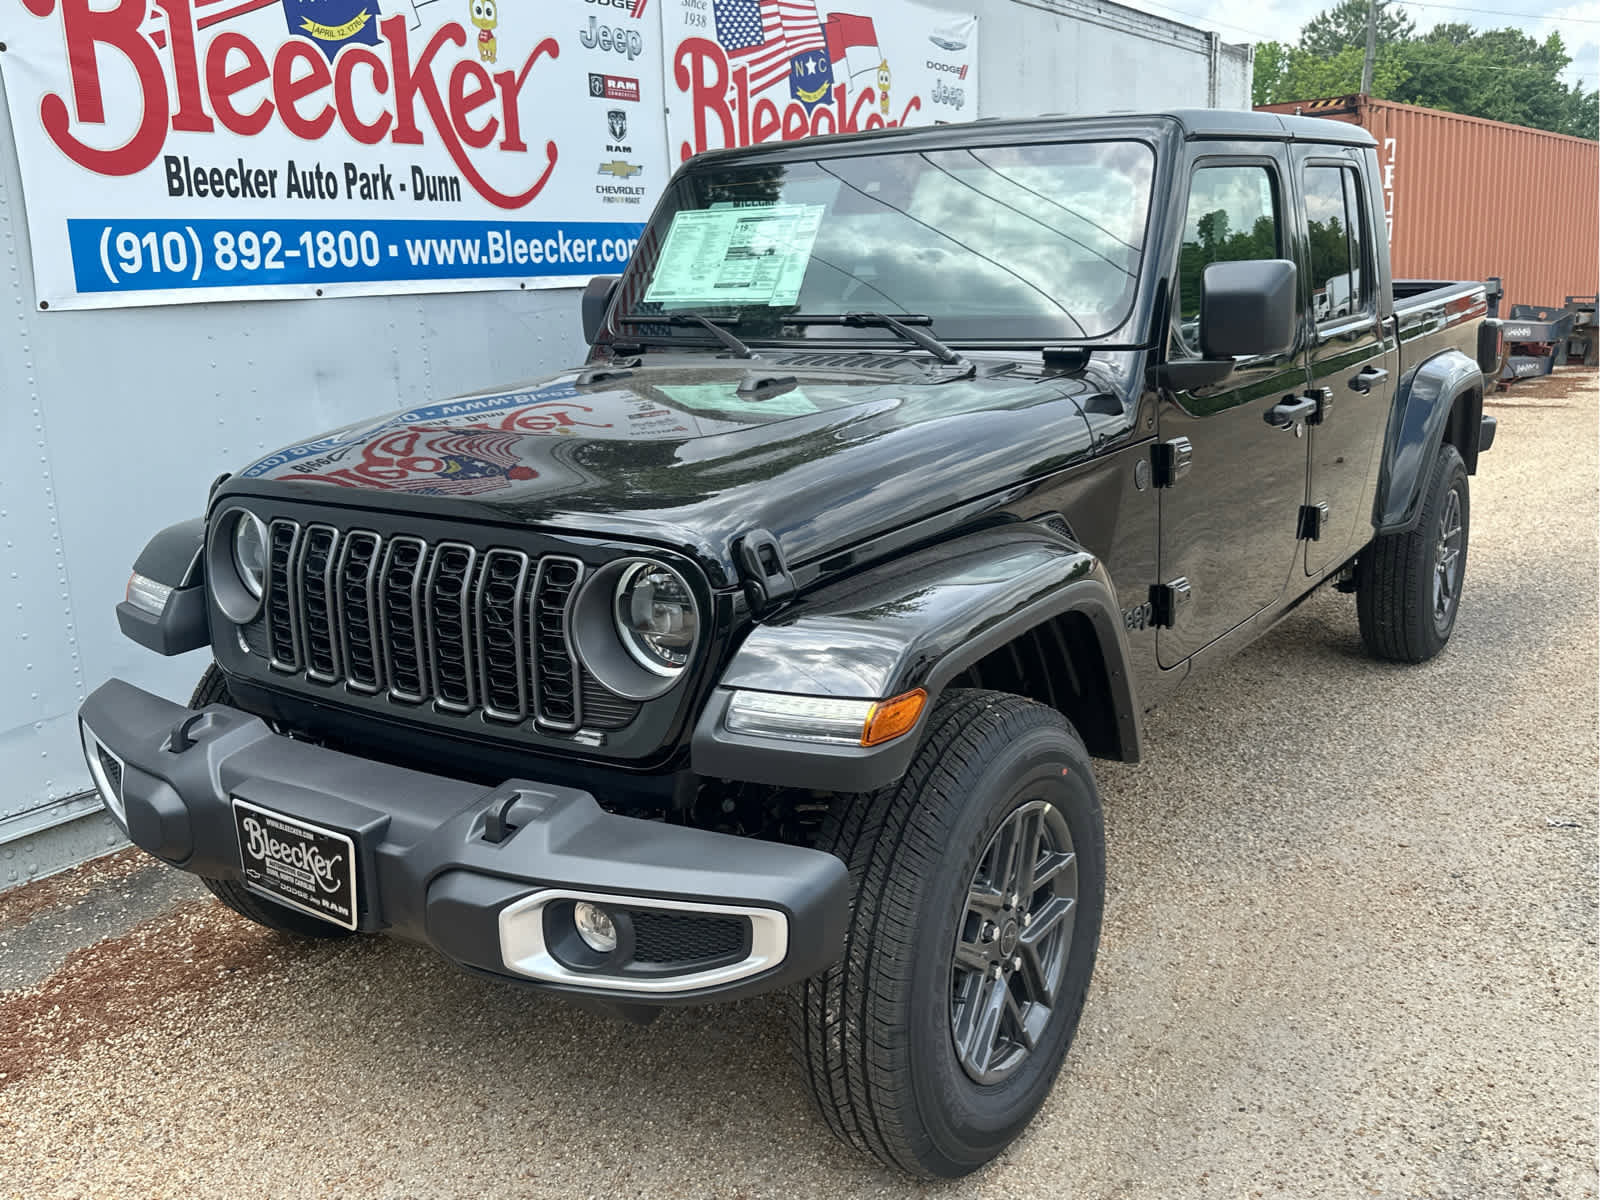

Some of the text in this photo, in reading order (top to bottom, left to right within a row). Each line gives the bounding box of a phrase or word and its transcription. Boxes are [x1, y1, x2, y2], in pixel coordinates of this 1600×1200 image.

[684, 12, 707, 28] 1938
[580, 16, 642, 61] Jeep
[795, 57, 827, 77] N C
[926, 61, 962, 75] DODGE
[607, 80, 637, 91] RAM
[932, 79, 964, 111] Jeep
[28, 0, 560, 210] Bleecker
[606, 145, 632, 153] RAM
[164, 155, 462, 202] Bleecker Auto Park Dunn
[596, 185, 645, 196] CHEVROLET
[99, 226, 203, 284] (910)
[213, 230, 380, 271] 892-1800
[243, 817, 342, 893] Bleecker
[321, 899, 349, 917] RAM
